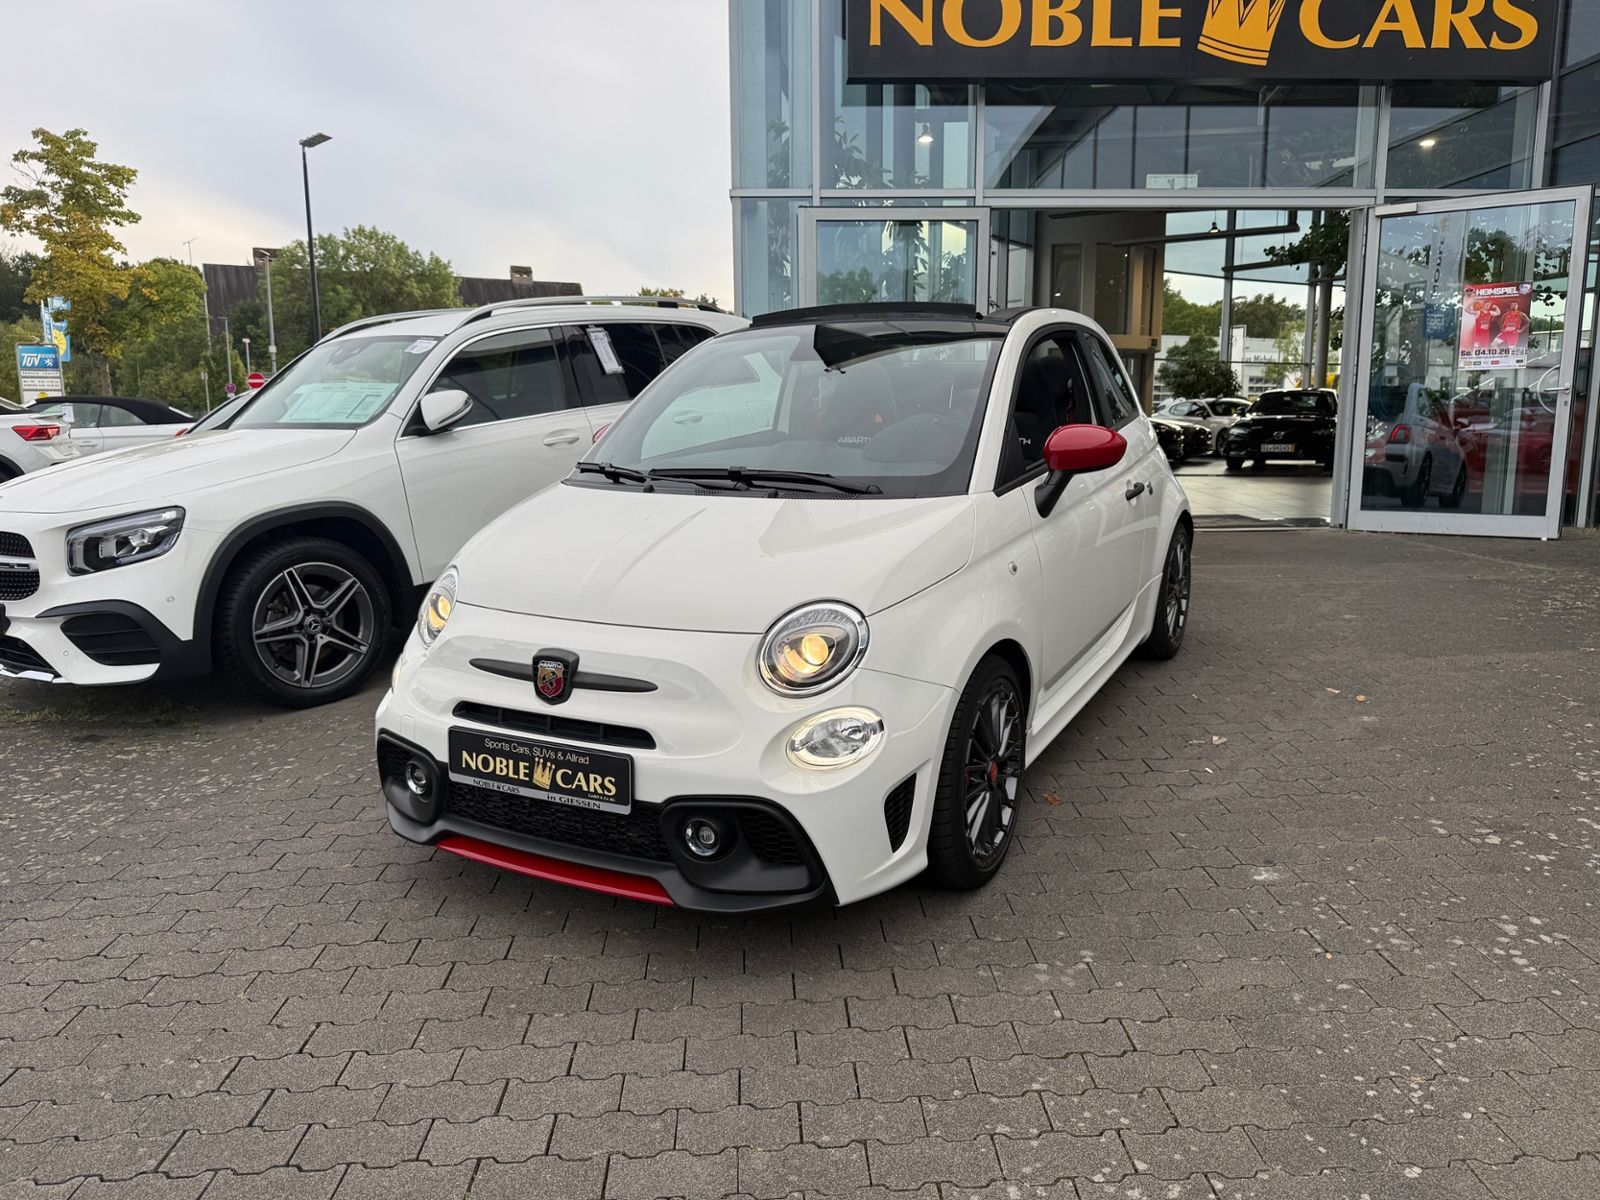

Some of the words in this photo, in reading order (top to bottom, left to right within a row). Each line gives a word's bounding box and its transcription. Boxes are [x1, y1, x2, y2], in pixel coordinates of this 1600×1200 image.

[869, 0, 1182, 47] NOBLE
[1299, 0, 1539, 50] CARS
[1475, 286, 1519, 296] HEIMSPIEL
[484, 738, 510, 751] Sports
[510, 742, 532, 756] Cars,
[532, 746, 556, 760] SUVs
[556, 751, 564, 760] &
[565, 752, 589, 765] Allrad
[462, 750, 530, 781] NOBLE
[555, 768, 617, 796] CARS
[473, 778, 496, 788] NOBLE
[501, 784, 520, 794] CARS
[547, 793, 556, 801] in
[558, 795, 601, 809] GIESSEN
